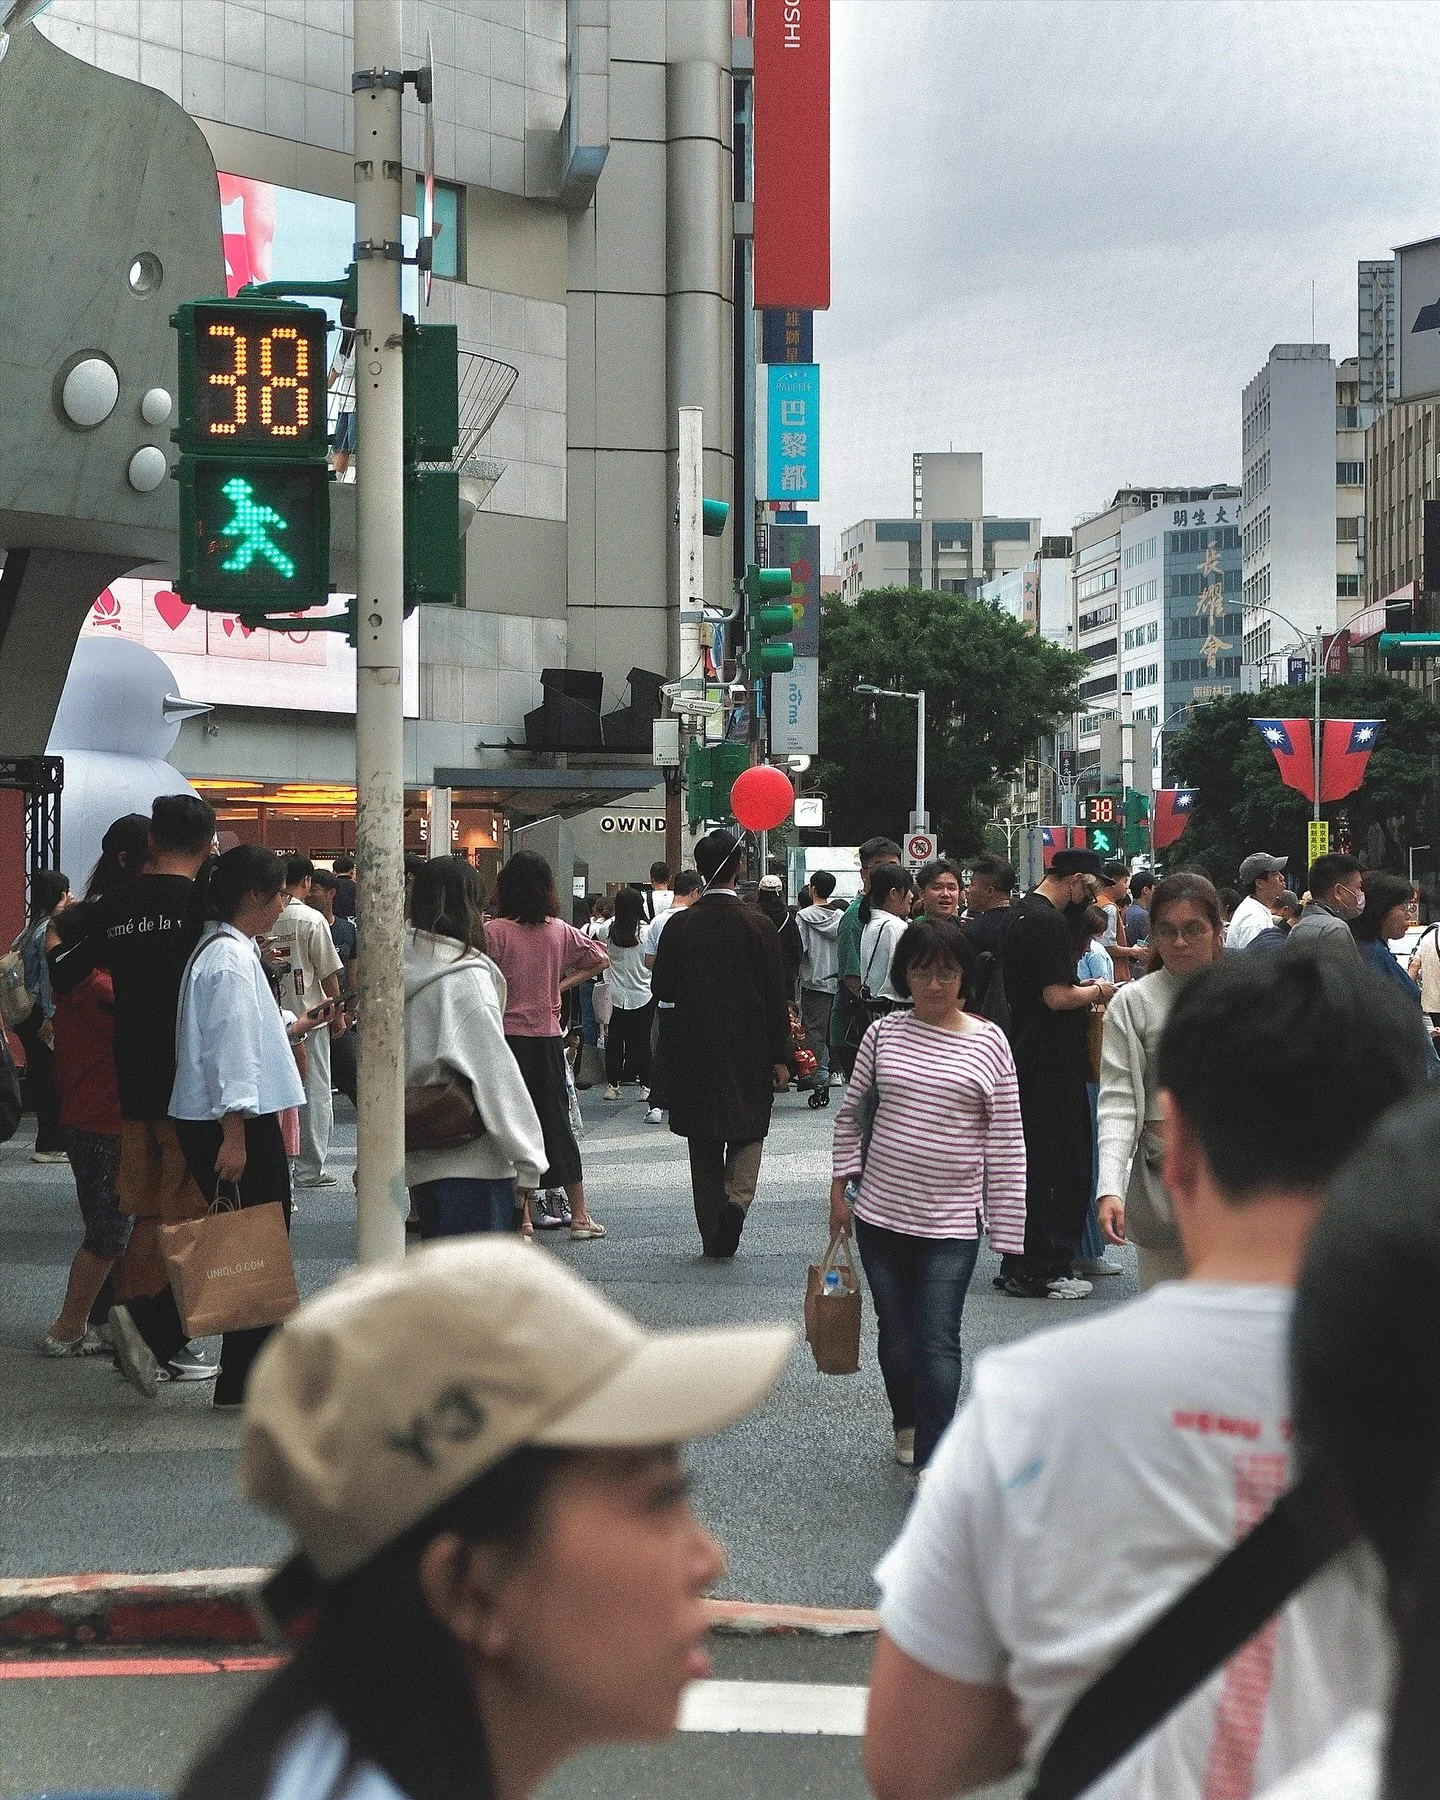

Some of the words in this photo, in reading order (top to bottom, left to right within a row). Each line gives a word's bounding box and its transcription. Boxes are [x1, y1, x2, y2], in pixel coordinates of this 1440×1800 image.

[208, 325, 309, 436] 38
[781, 399, 808, 491] 巴黎都
[1090, 798, 1113, 823] 38
[601, 817, 667, 832] OWND
[138, 916, 155, 932] de
[158, 914, 172, 931] la
